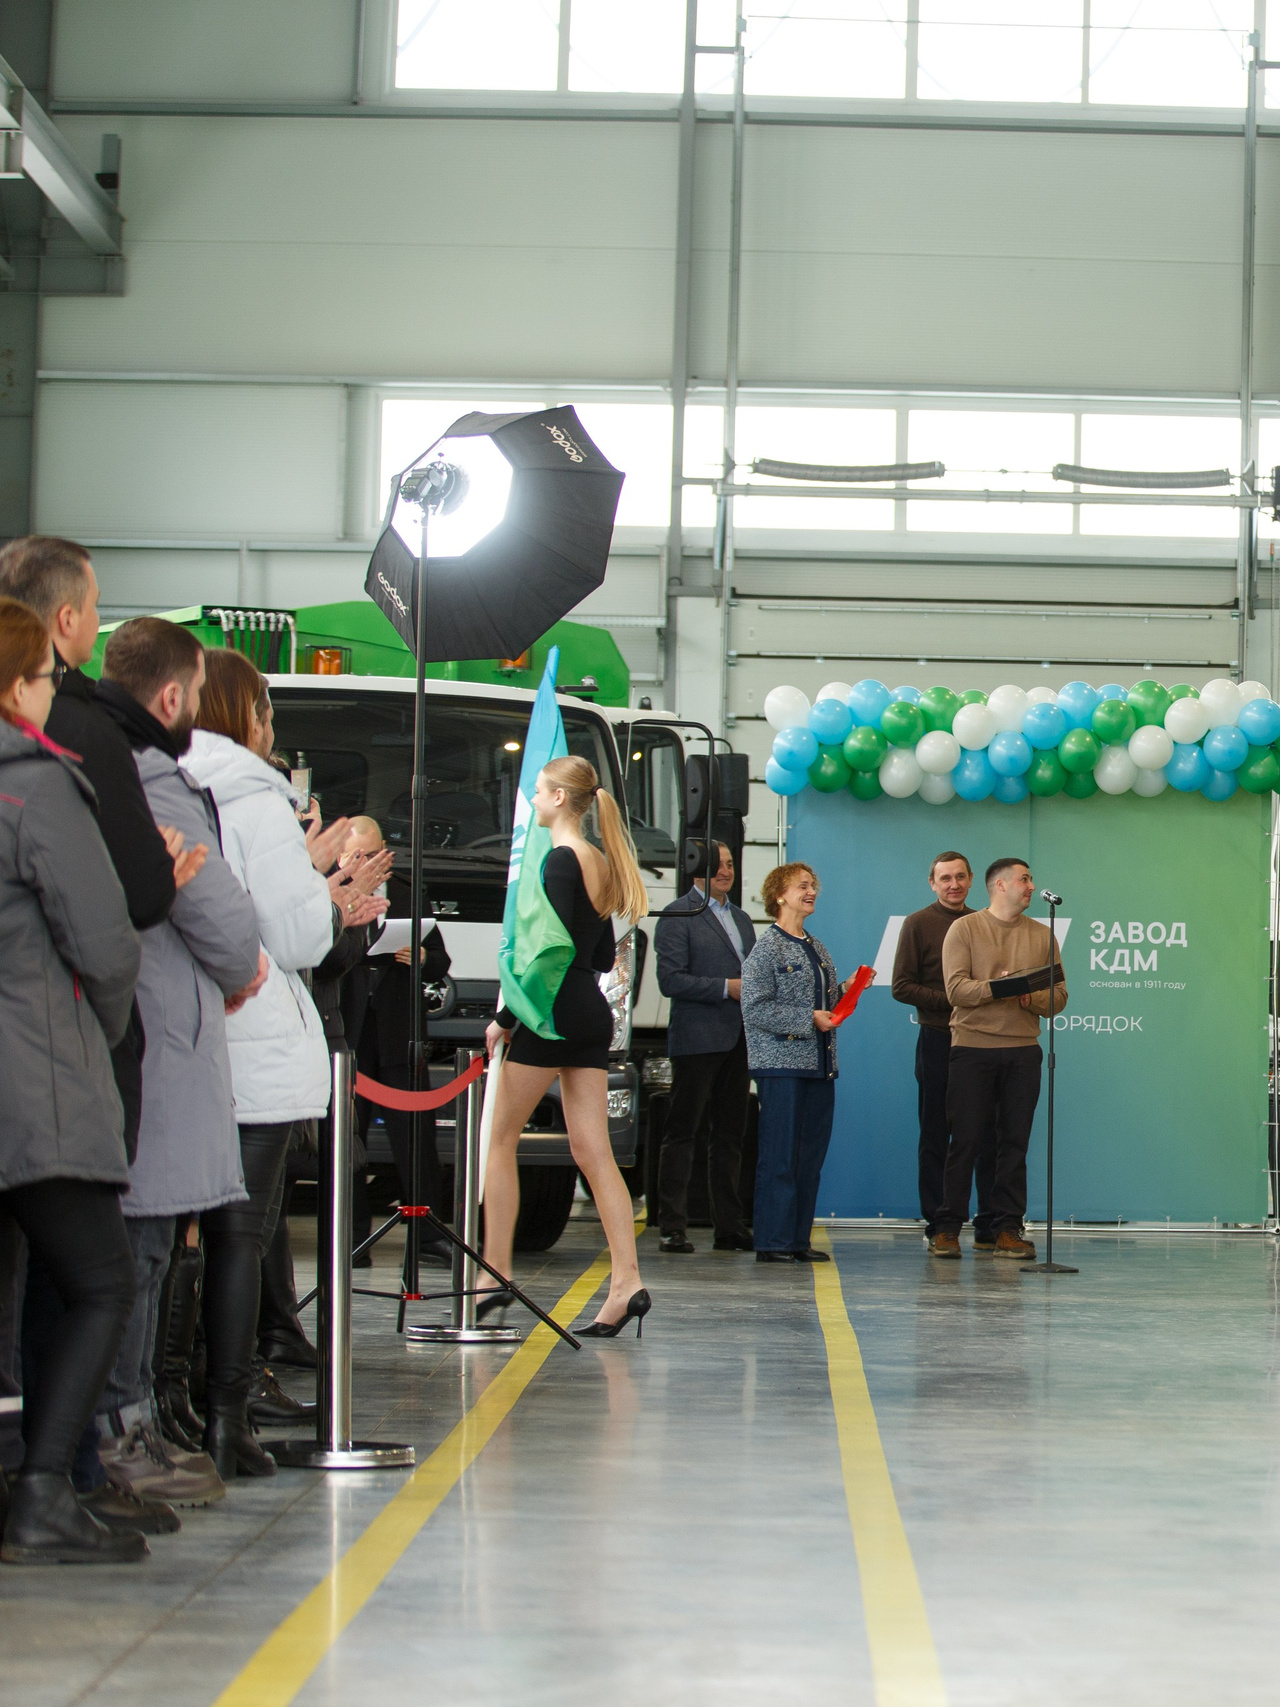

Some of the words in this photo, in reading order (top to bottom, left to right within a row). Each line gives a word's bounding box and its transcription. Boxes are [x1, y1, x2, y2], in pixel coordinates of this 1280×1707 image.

[545, 425, 583, 463] Godox
[377, 571, 407, 616] Godox
[1089, 920, 1188, 948] ЗАВОД
[1090, 948, 1158, 975] КДМ
[1089, 980, 1132, 989] основан
[1135, 981, 1141, 989] в
[1143, 980, 1162, 989] 1911
[1163, 981, 1187, 991] году
